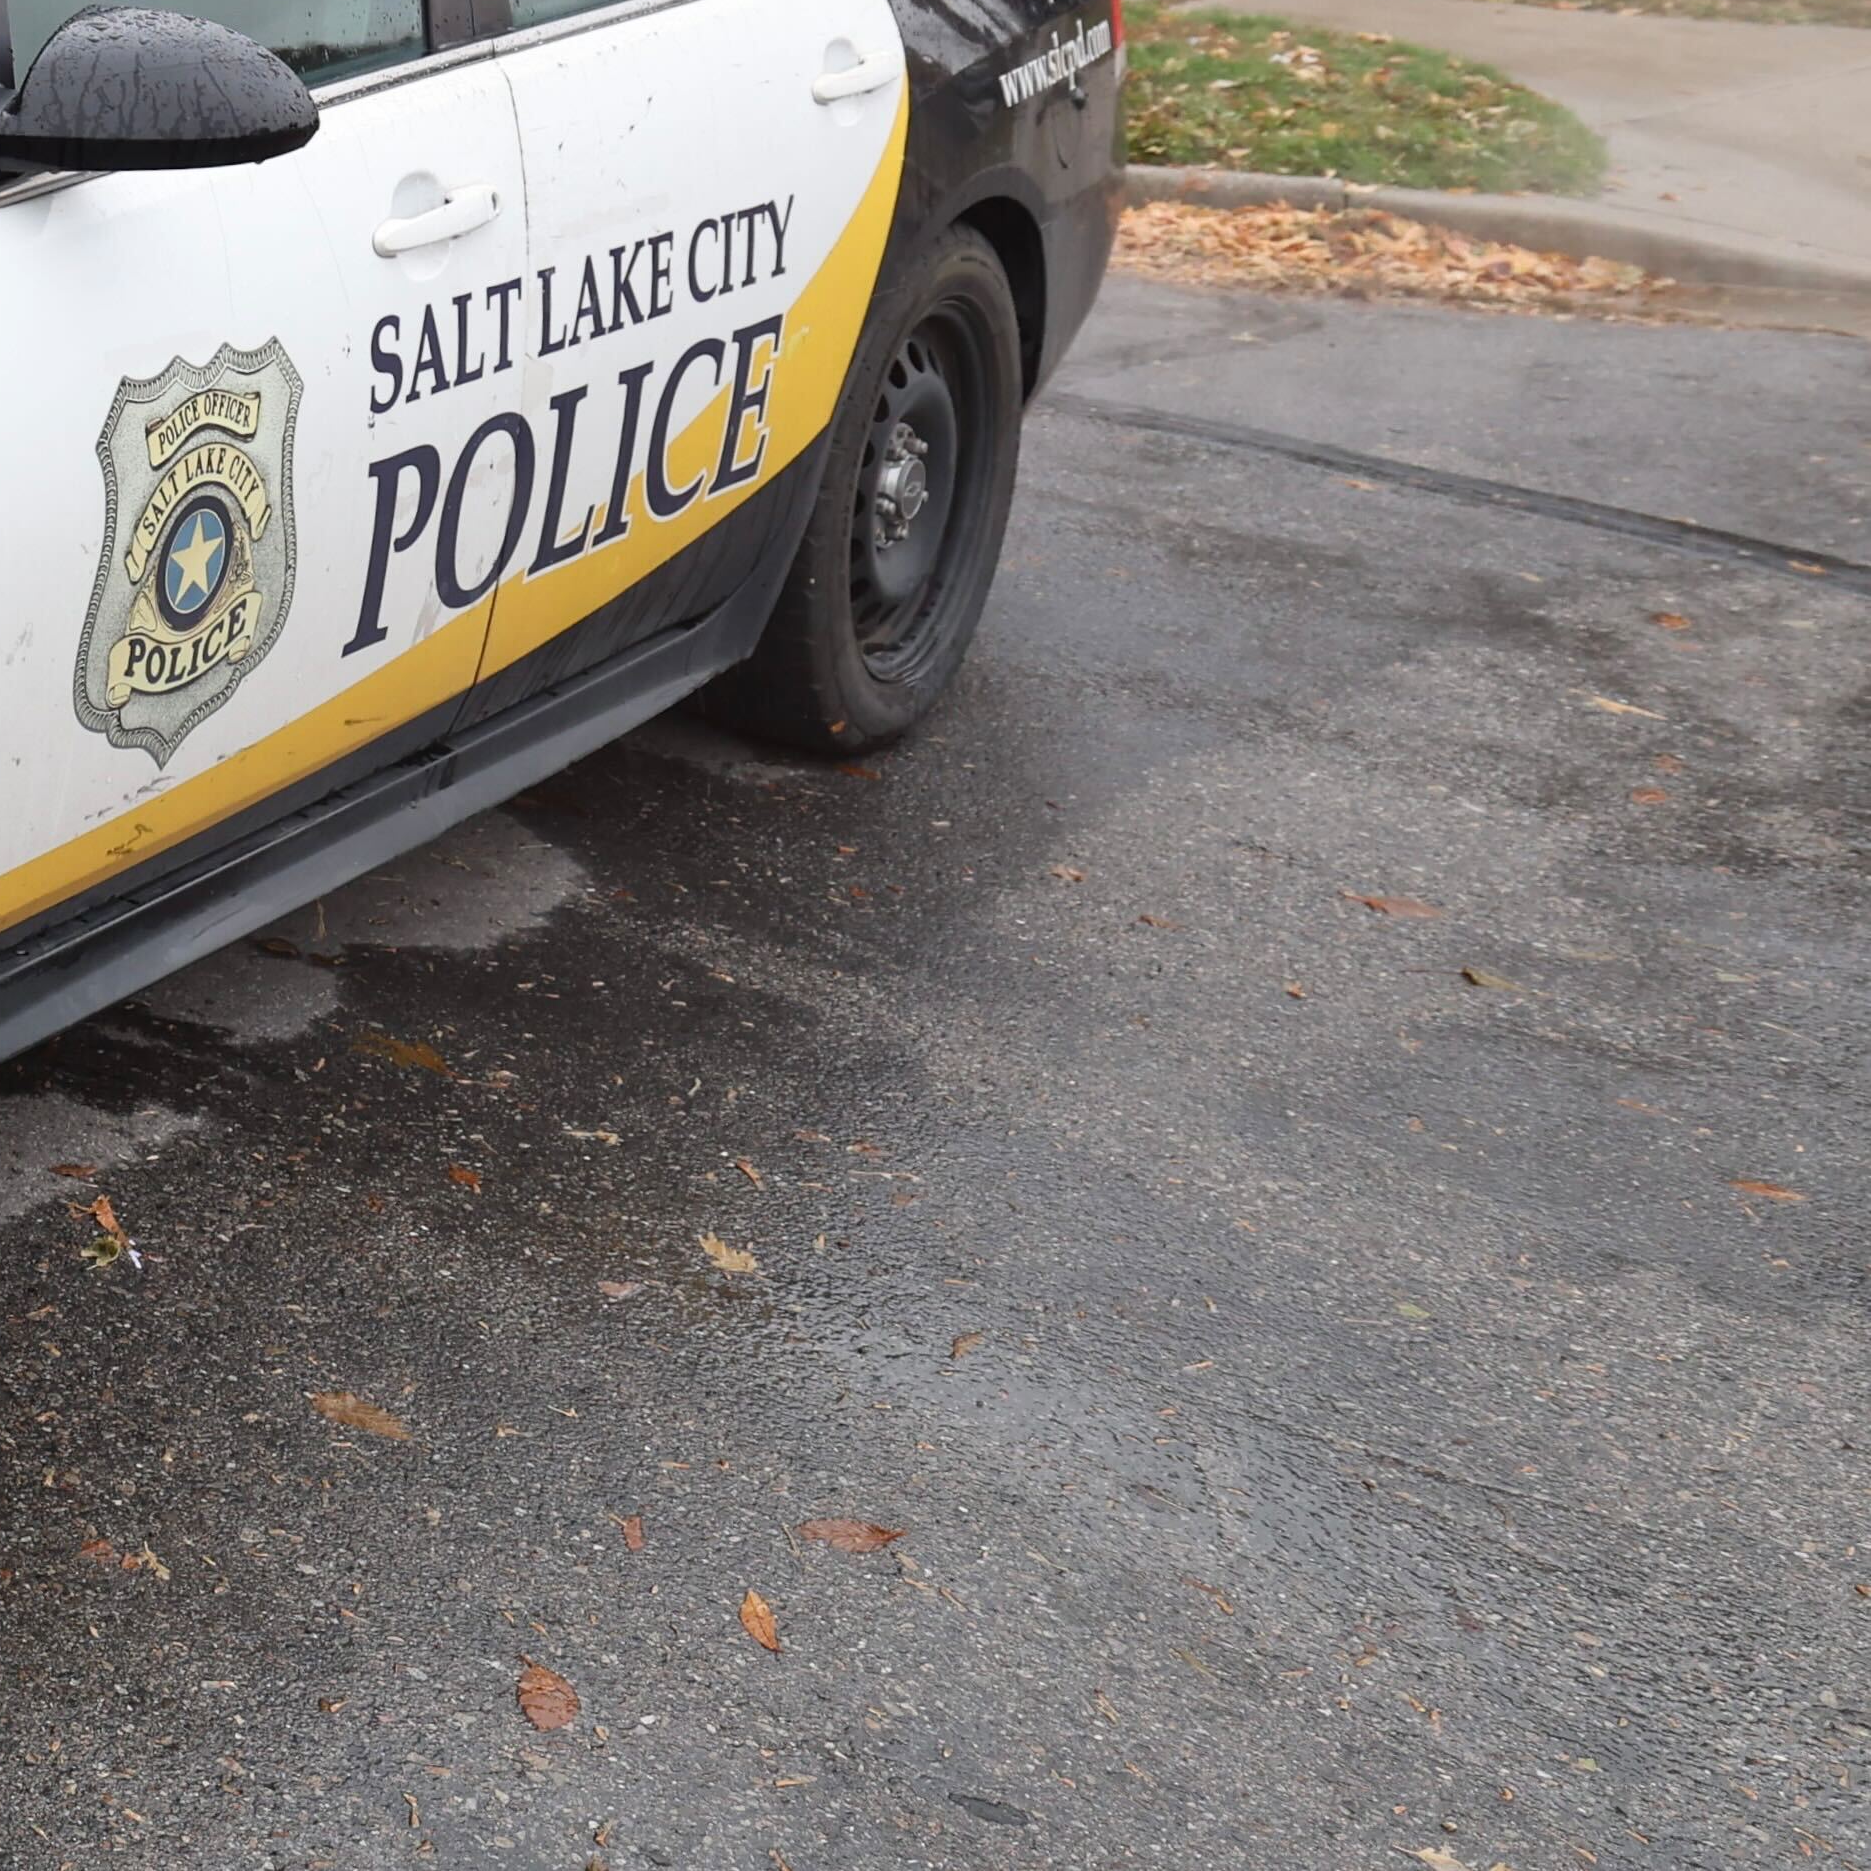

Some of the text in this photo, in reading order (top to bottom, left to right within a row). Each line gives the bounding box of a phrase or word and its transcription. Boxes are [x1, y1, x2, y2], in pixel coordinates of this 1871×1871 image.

[369, 194, 794, 415] SALT LAKE CITY
[159, 394, 252, 456] POLICE OFFICER
[144, 446, 262, 535] SALT LAKE CITY
[341, 313, 785, 659] POLICE
[123, 594, 248, 685] POLICE
